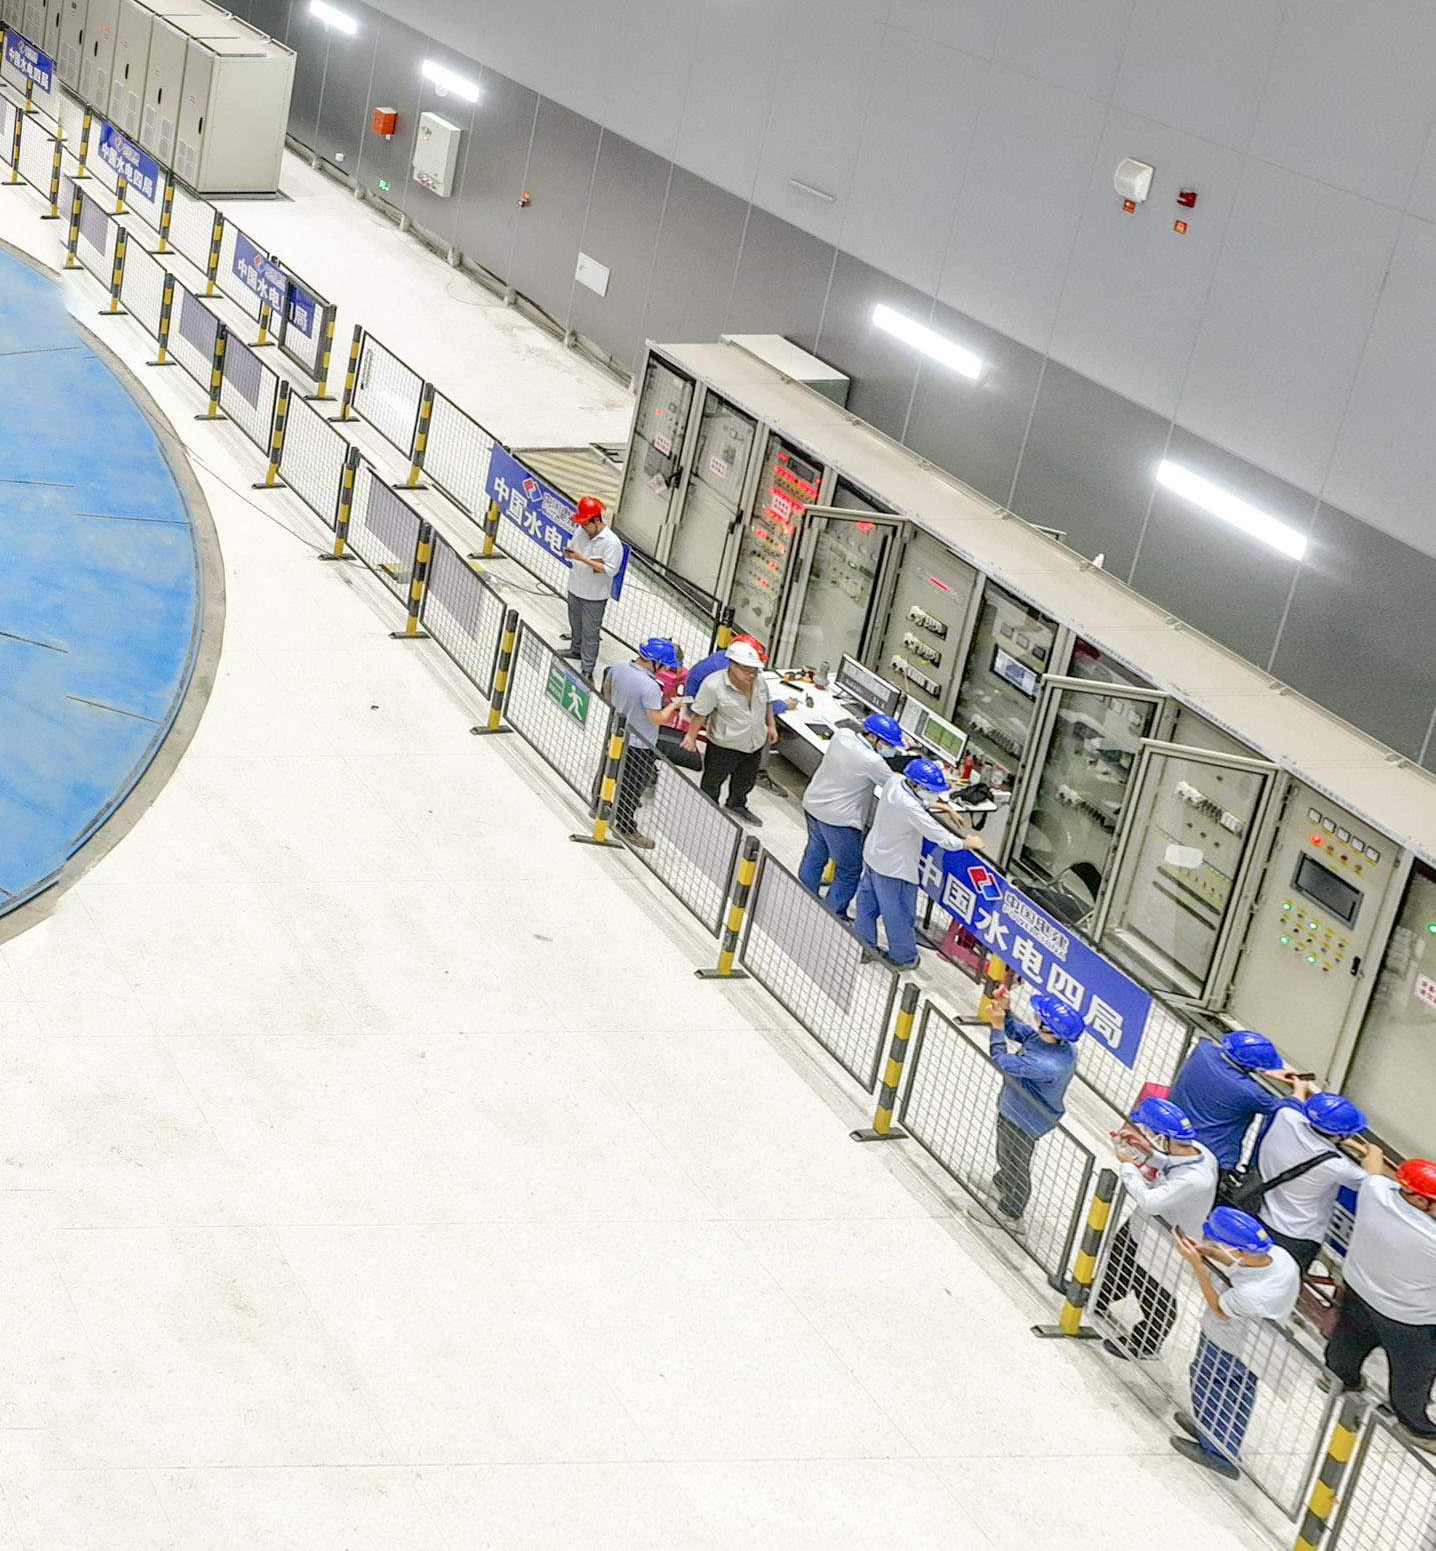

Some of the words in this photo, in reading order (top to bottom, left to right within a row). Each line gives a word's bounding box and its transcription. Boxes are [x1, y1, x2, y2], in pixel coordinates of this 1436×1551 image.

[101, 141, 153, 199] 中国水电四局
[917, 853, 1125, 1050] 中国水电四局
